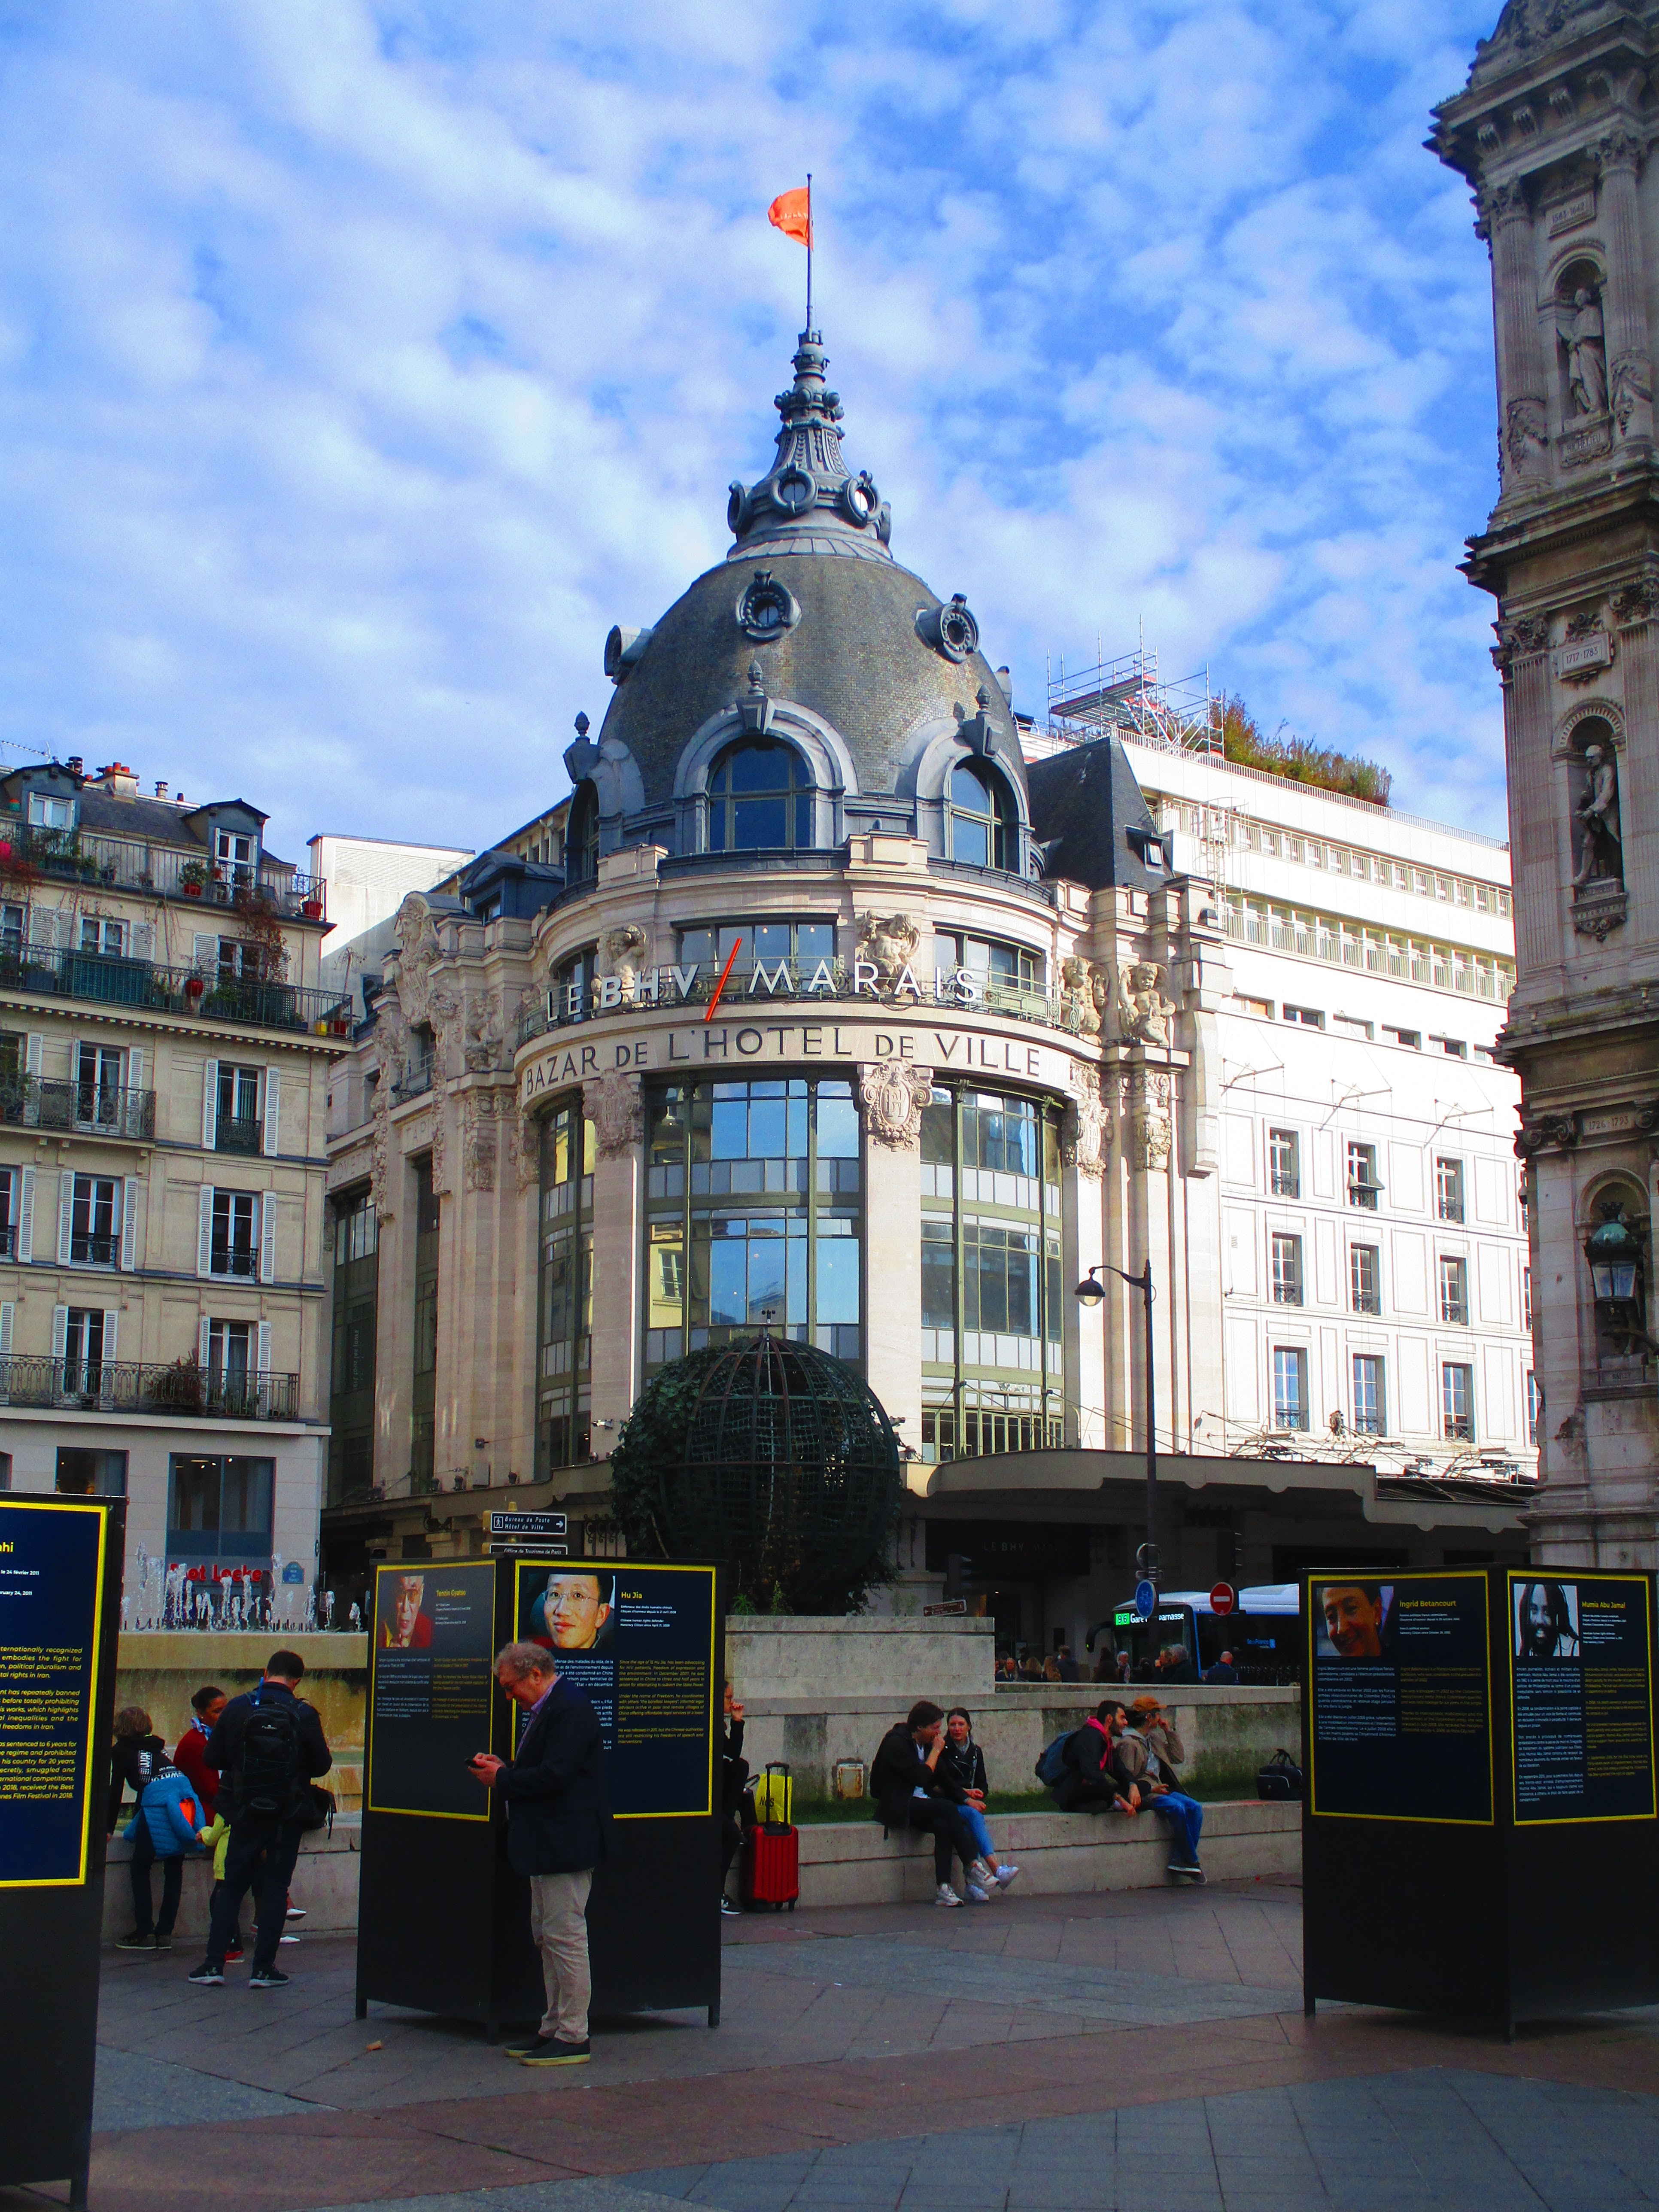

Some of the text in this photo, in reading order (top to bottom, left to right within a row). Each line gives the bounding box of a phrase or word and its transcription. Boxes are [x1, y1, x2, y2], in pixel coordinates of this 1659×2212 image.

[547, 982, 581, 1022] LE
[600, 964, 699, 1009] BHV
[748, 959, 978, 1003] MARAIS
[526, 1027, 1040, 1097] BAZAR DE L'HOTEL DE VILLE
[1400, 1600, 1419, 1609] Ingrid
[1118, 1615, 1127, 1623] 96
[760, 1796, 774, 1807] NS
